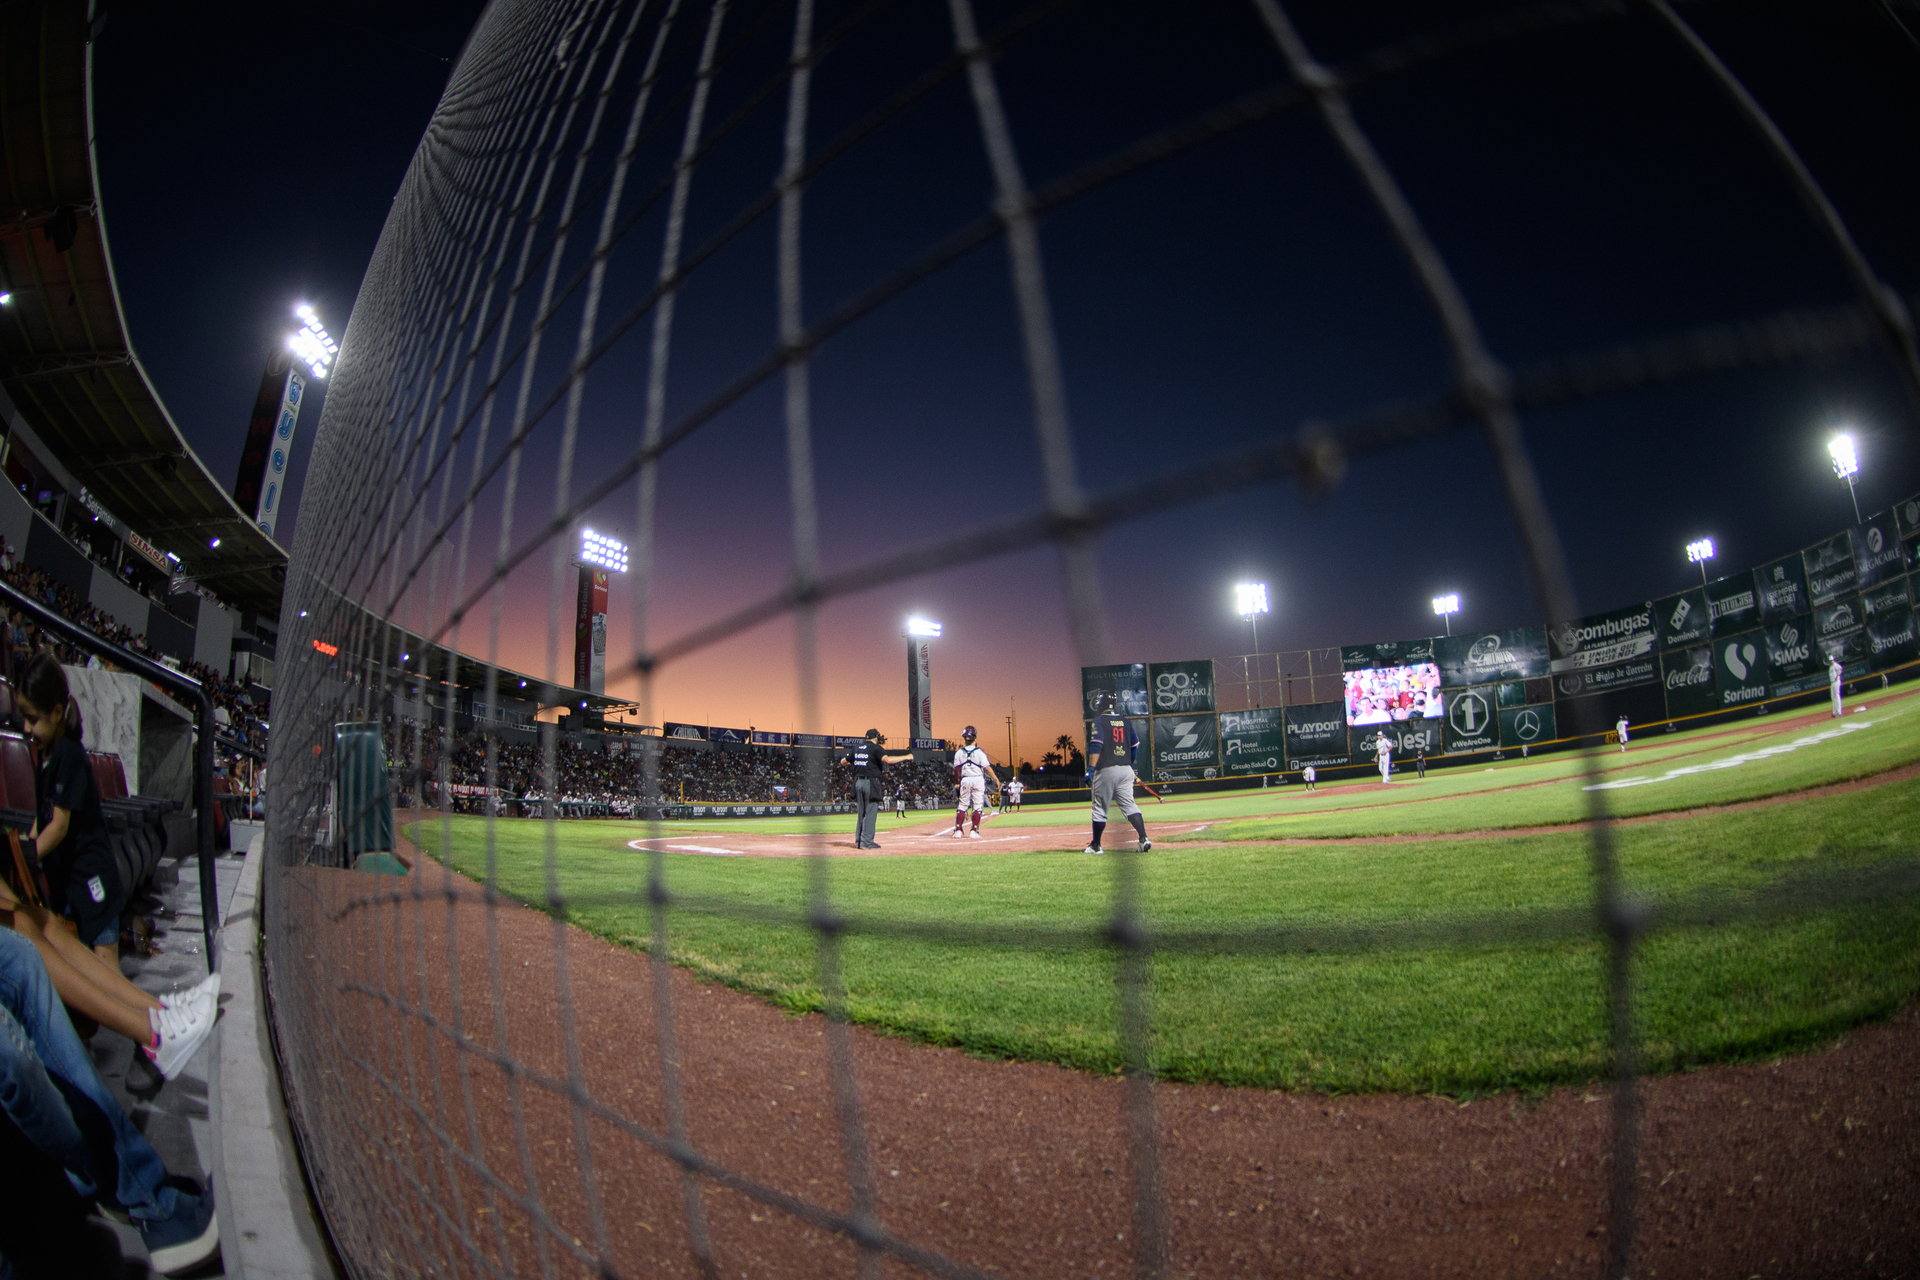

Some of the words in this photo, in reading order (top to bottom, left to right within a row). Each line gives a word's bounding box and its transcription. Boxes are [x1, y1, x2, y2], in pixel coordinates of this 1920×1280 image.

[87, 494, 114, 528] Setramex
[130, 533, 167, 567] SIMSA
[1858, 547, 1900, 574] MEGACABLE
[594, 584, 608, 592] Soriana
[581, 582, 589, 619] Soriana
[1576, 613, 1650, 641] combugas
[1822, 615, 1854, 634] Electrolit
[1667, 629, 1700, 644] Domino's
[1882, 629, 1914, 649] TOYOTA
[1588, 649, 1638, 665] ENCIENDE
[1087, 671, 1143, 679] MULTIMEDIOS
[1585, 673, 1594, 684] El
[1595, 670, 1616, 683] Siglo
[1616, 669, 1625, 677] de
[1177, 688, 1206, 698] MERAKI
[1724, 686, 1765, 703] Soriana
[1241, 718, 1268, 726] HOSPITAL
[1462, 698, 1475, 730] 1
[1113, 727, 1124, 743] 91
[1287, 721, 1341, 734] PLAYDOIT
[915, 738, 940, 748] TECATE
[1452, 738, 1491, 748] #WeAreOne
[1160, 749, 1210, 762] Setramex
